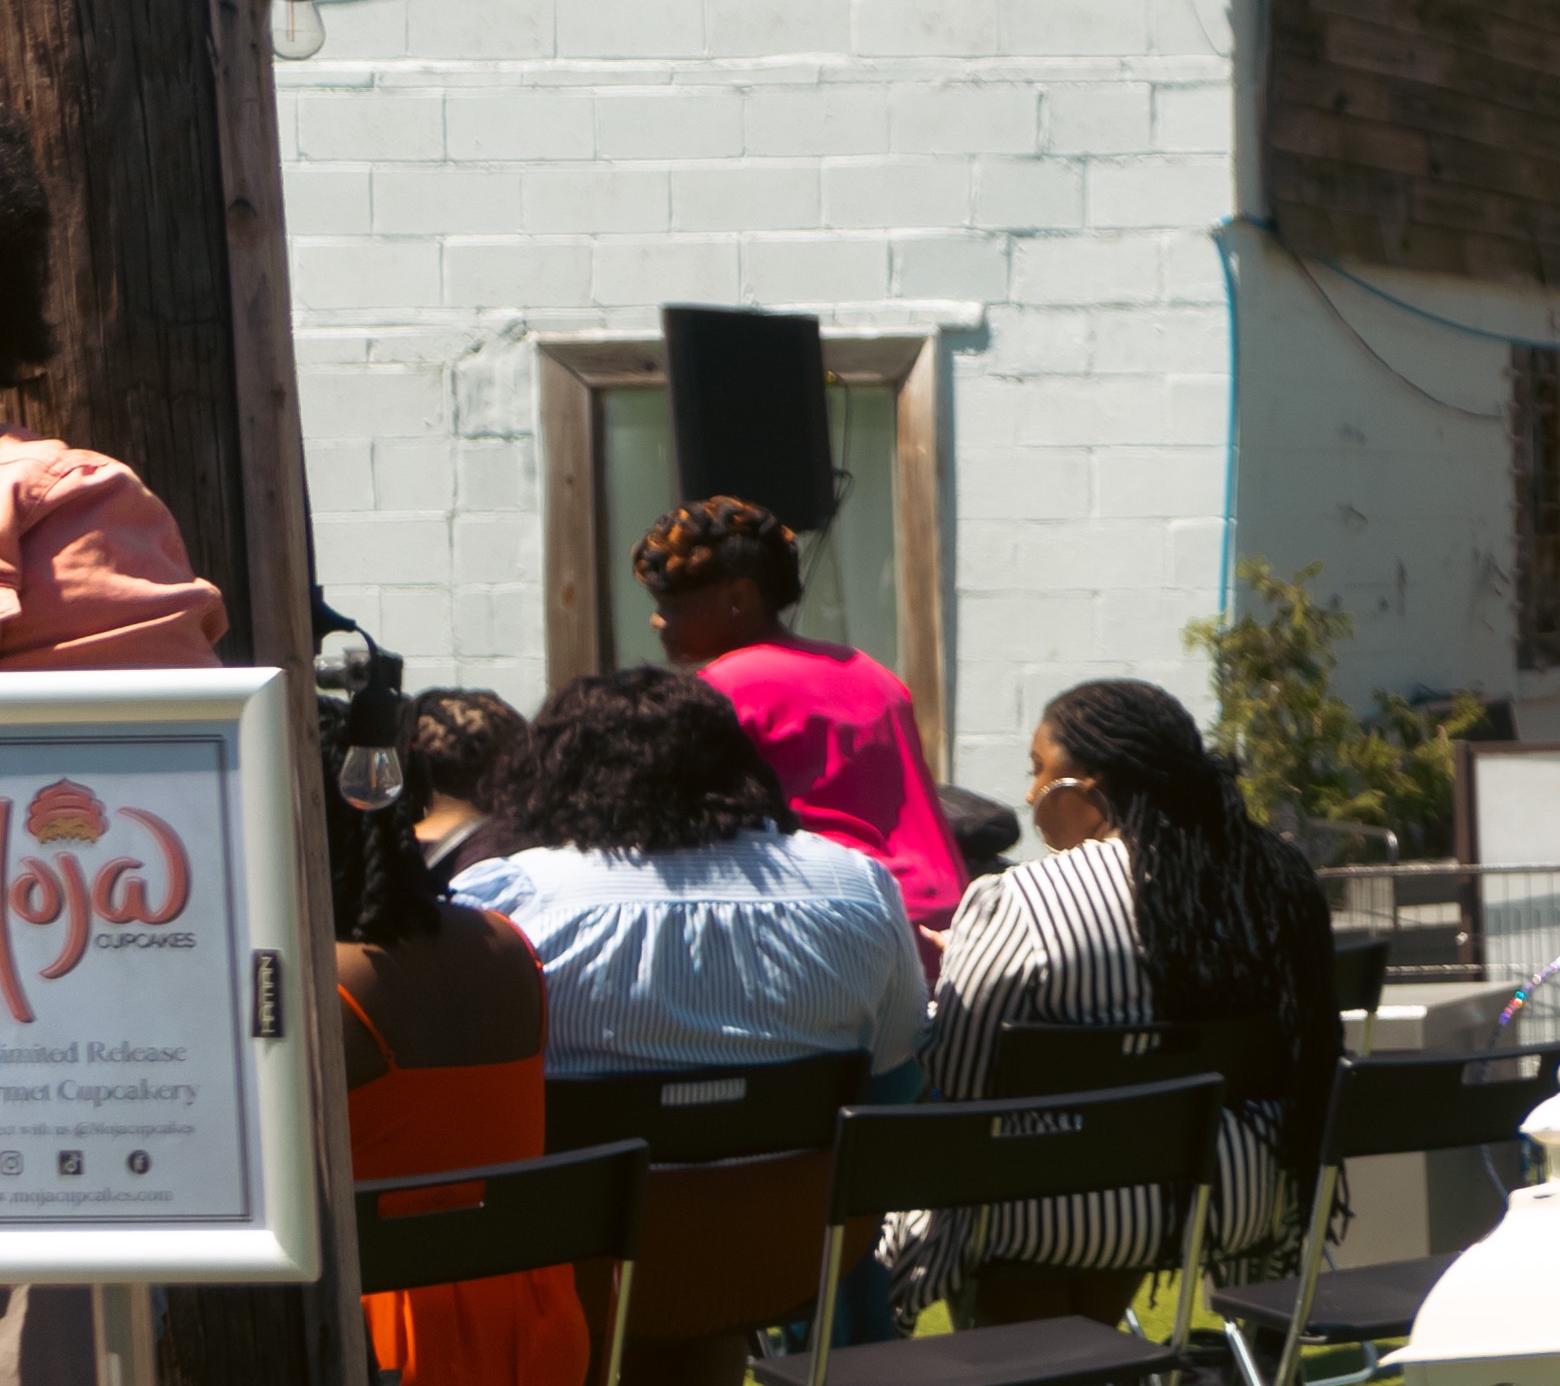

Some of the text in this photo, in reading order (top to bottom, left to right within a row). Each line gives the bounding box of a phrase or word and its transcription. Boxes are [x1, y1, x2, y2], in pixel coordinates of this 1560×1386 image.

[0, 796, 192, 1024] oja
[95, 932, 197, 950] CUPCAKES
[0, 1041, 188, 1063] imited Release
[57, 1079, 198, 1106] Cupcakery
